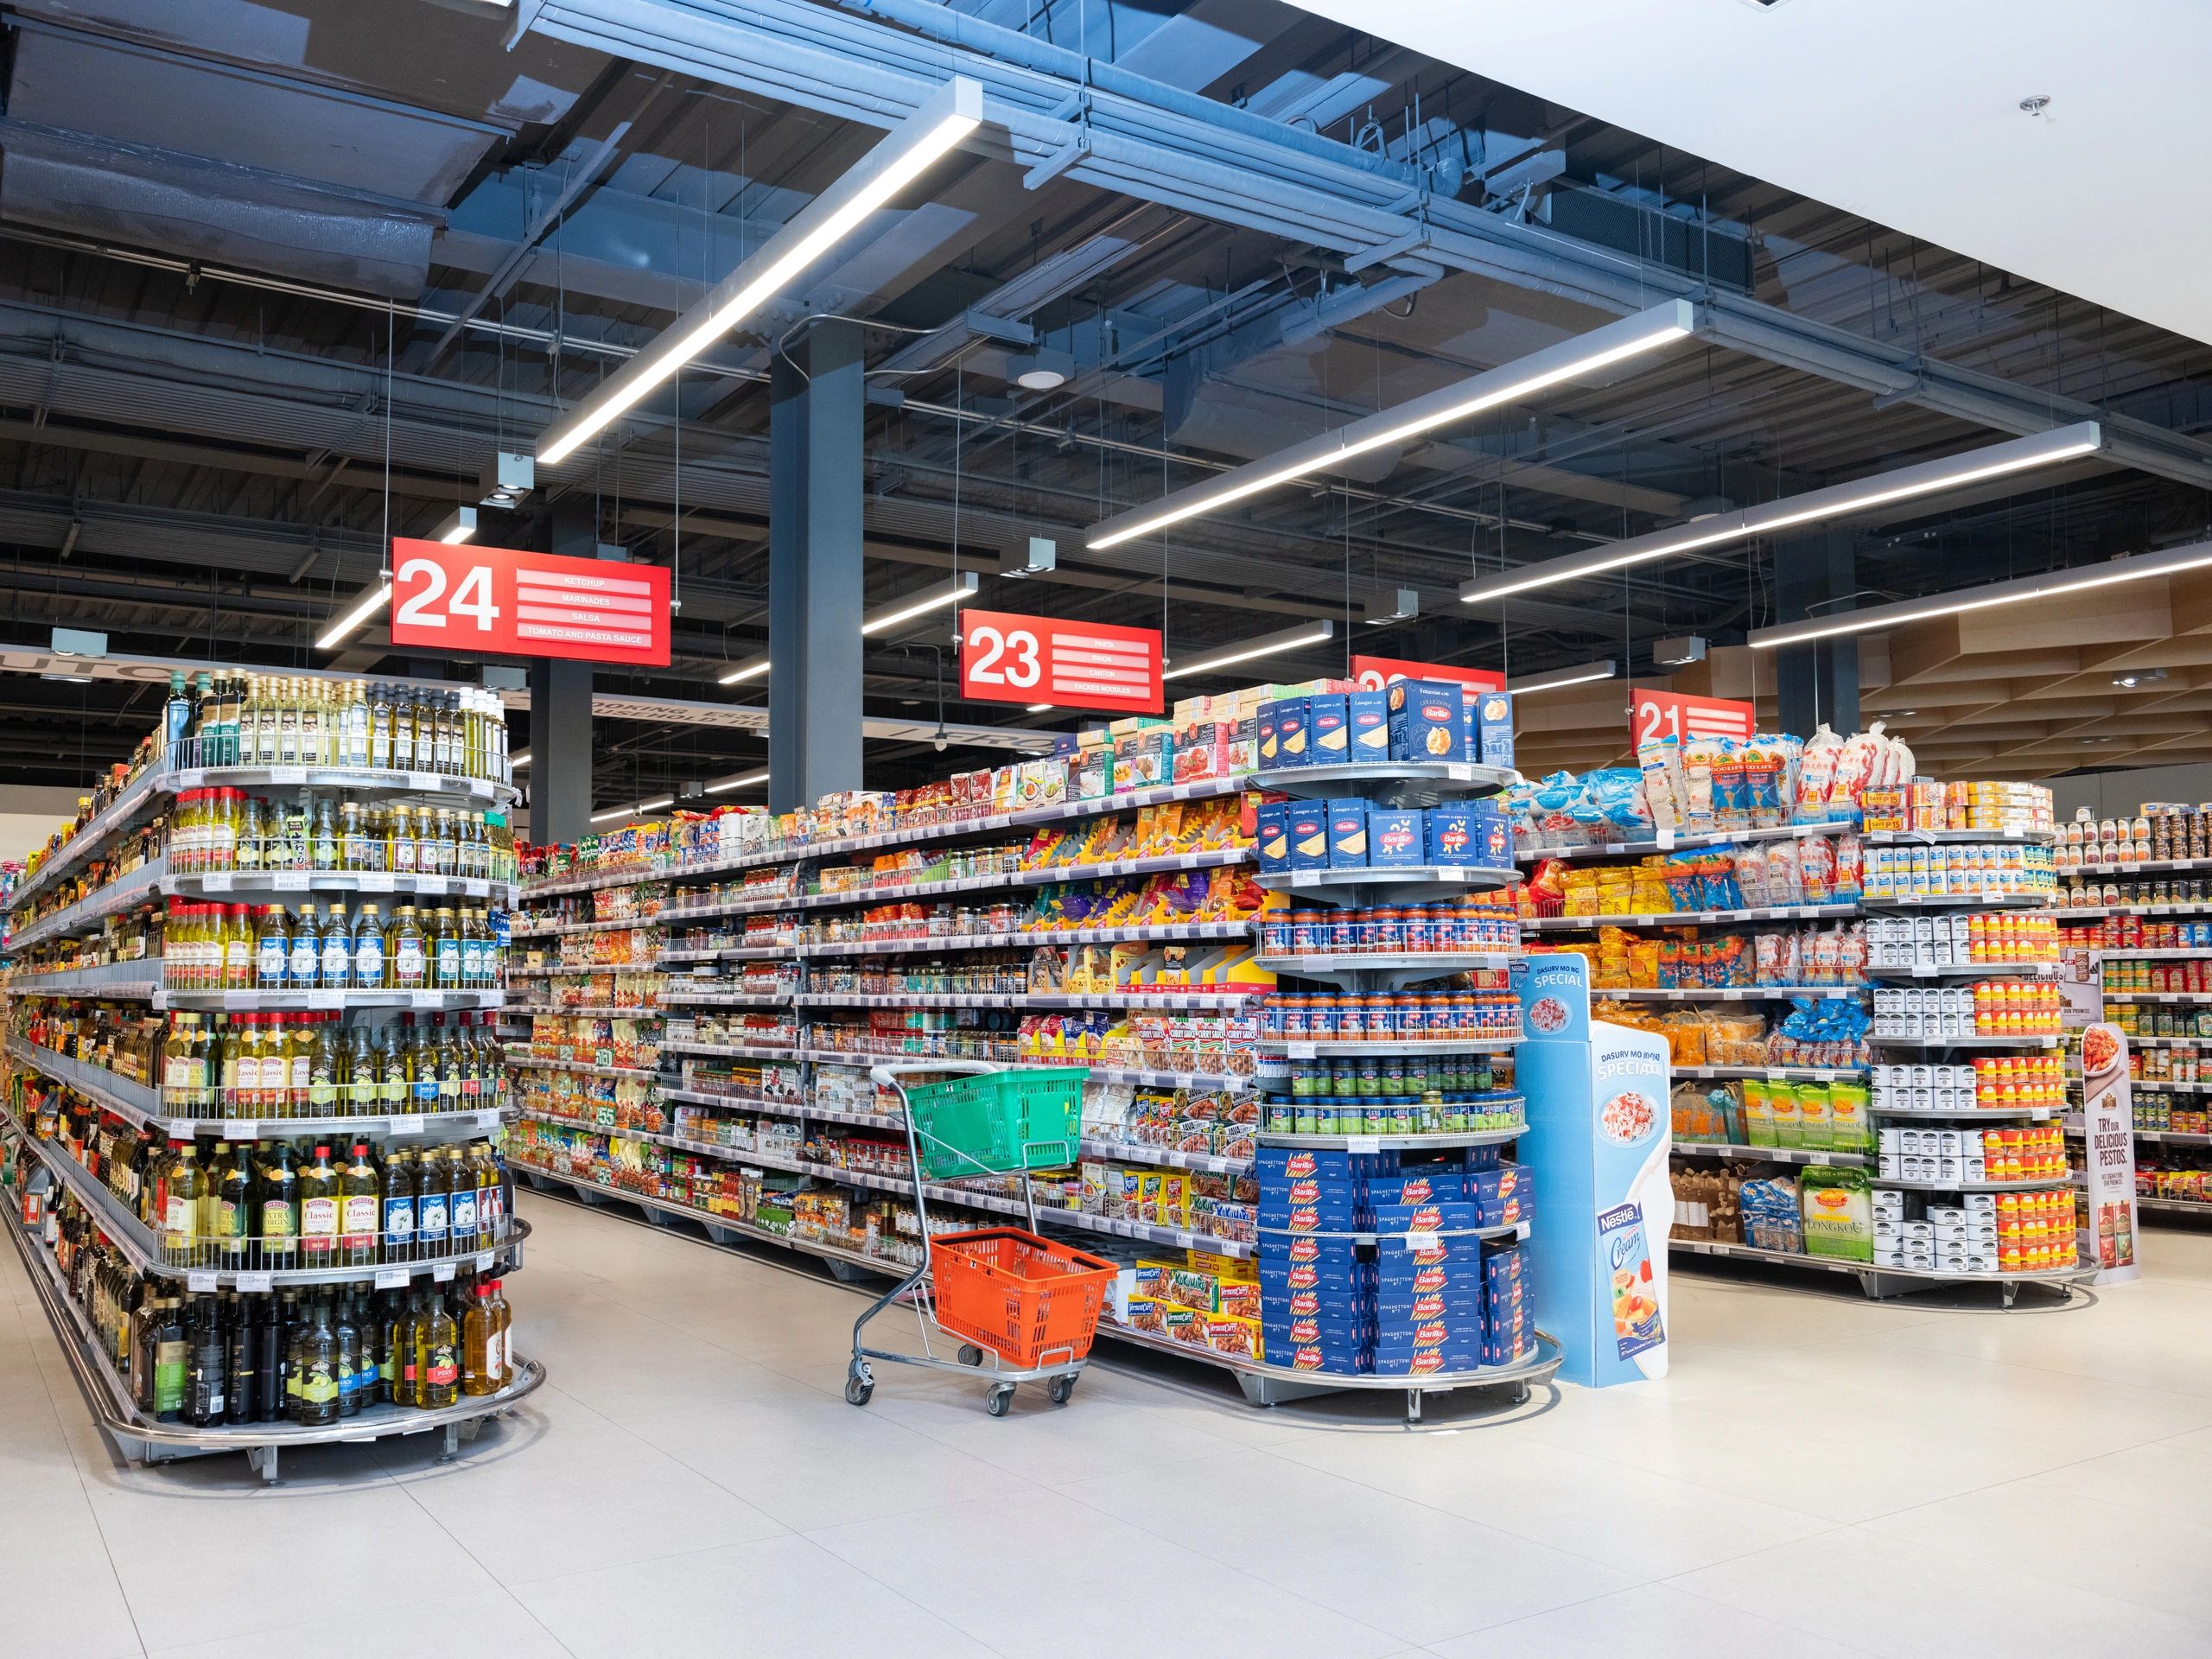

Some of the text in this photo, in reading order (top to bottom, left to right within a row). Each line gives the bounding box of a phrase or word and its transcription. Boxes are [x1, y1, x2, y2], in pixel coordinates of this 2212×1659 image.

[565, 575, 606, 588] KETCHUP
[397, 558, 500, 632] 24
[562, 594, 611, 607] MARINADES
[571, 612, 601, 623] SALSA
[527, 626, 643, 644] TOMATO AND PASTA SAUCE
[1094, 639, 1115, 649] PASTA
[969, 626, 1041, 689] 23
[1091, 654, 1113, 664] BIHON
[1089, 669, 1116, 678] CANTON
[1074, 683, 1131, 695] PACKED NOODLES
[1421, 699, 1452, 709] COLLEZIONE
[1427, 709, 1448, 718] Barilla
[1639, 701, 1681, 744] 21
[1536, 965, 1560, 976] DASURV
[1534, 972, 1584, 988] SPECIAL
[1601, 1051, 1629, 1062] DASURV
[1187, 1089, 1202, 1099] JAVA
[1232, 1091, 1246, 1102] JAVA
[1182, 1121, 1195, 1131] JAVA
[1227, 1126, 1242, 1136] JAVA
[2098, 1118, 2120, 1133] TRY OUR
[2094, 1133, 2128, 1150] DELICIOUS
[2100, 1149, 2128, 1166] PESTOS.
[304, 1211, 334, 1219] Classic
[346, 1208, 375, 1217] Classic
[1600, 1206, 1636, 1231] Nestlé
[1807, 1217, 1862, 1233] LONGKOU
[1610, 1230, 1641, 1272] Cream
[1294, 1300, 1317, 1308] Barilla
[1294, 1326, 1318, 1335] Barilla
[1419, 1330, 1444, 1338] Barilla
[1298, 1353, 1321, 1363] Barilla
